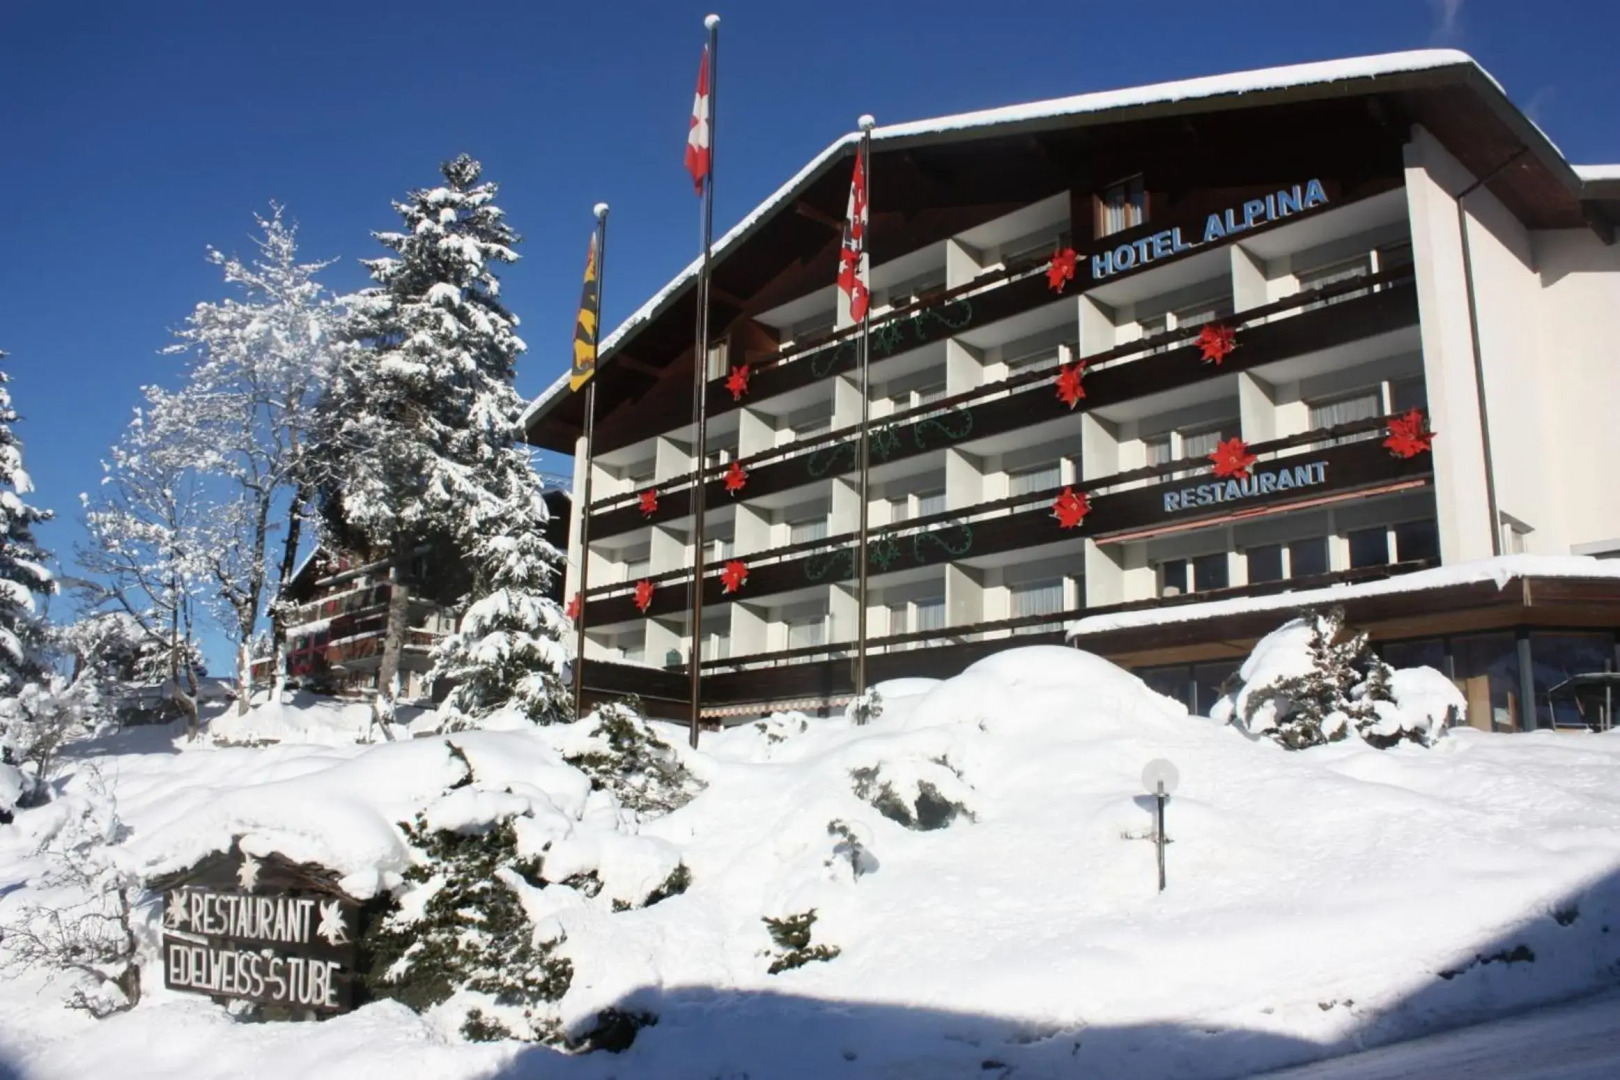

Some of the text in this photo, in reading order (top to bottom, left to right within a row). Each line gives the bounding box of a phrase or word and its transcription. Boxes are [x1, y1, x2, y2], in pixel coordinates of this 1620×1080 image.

[1092, 178, 1328, 278] HOTEL ALPINA
[1164, 461, 1329, 512] RESTAURANT
[191, 893, 315, 943] RESTAURANT
